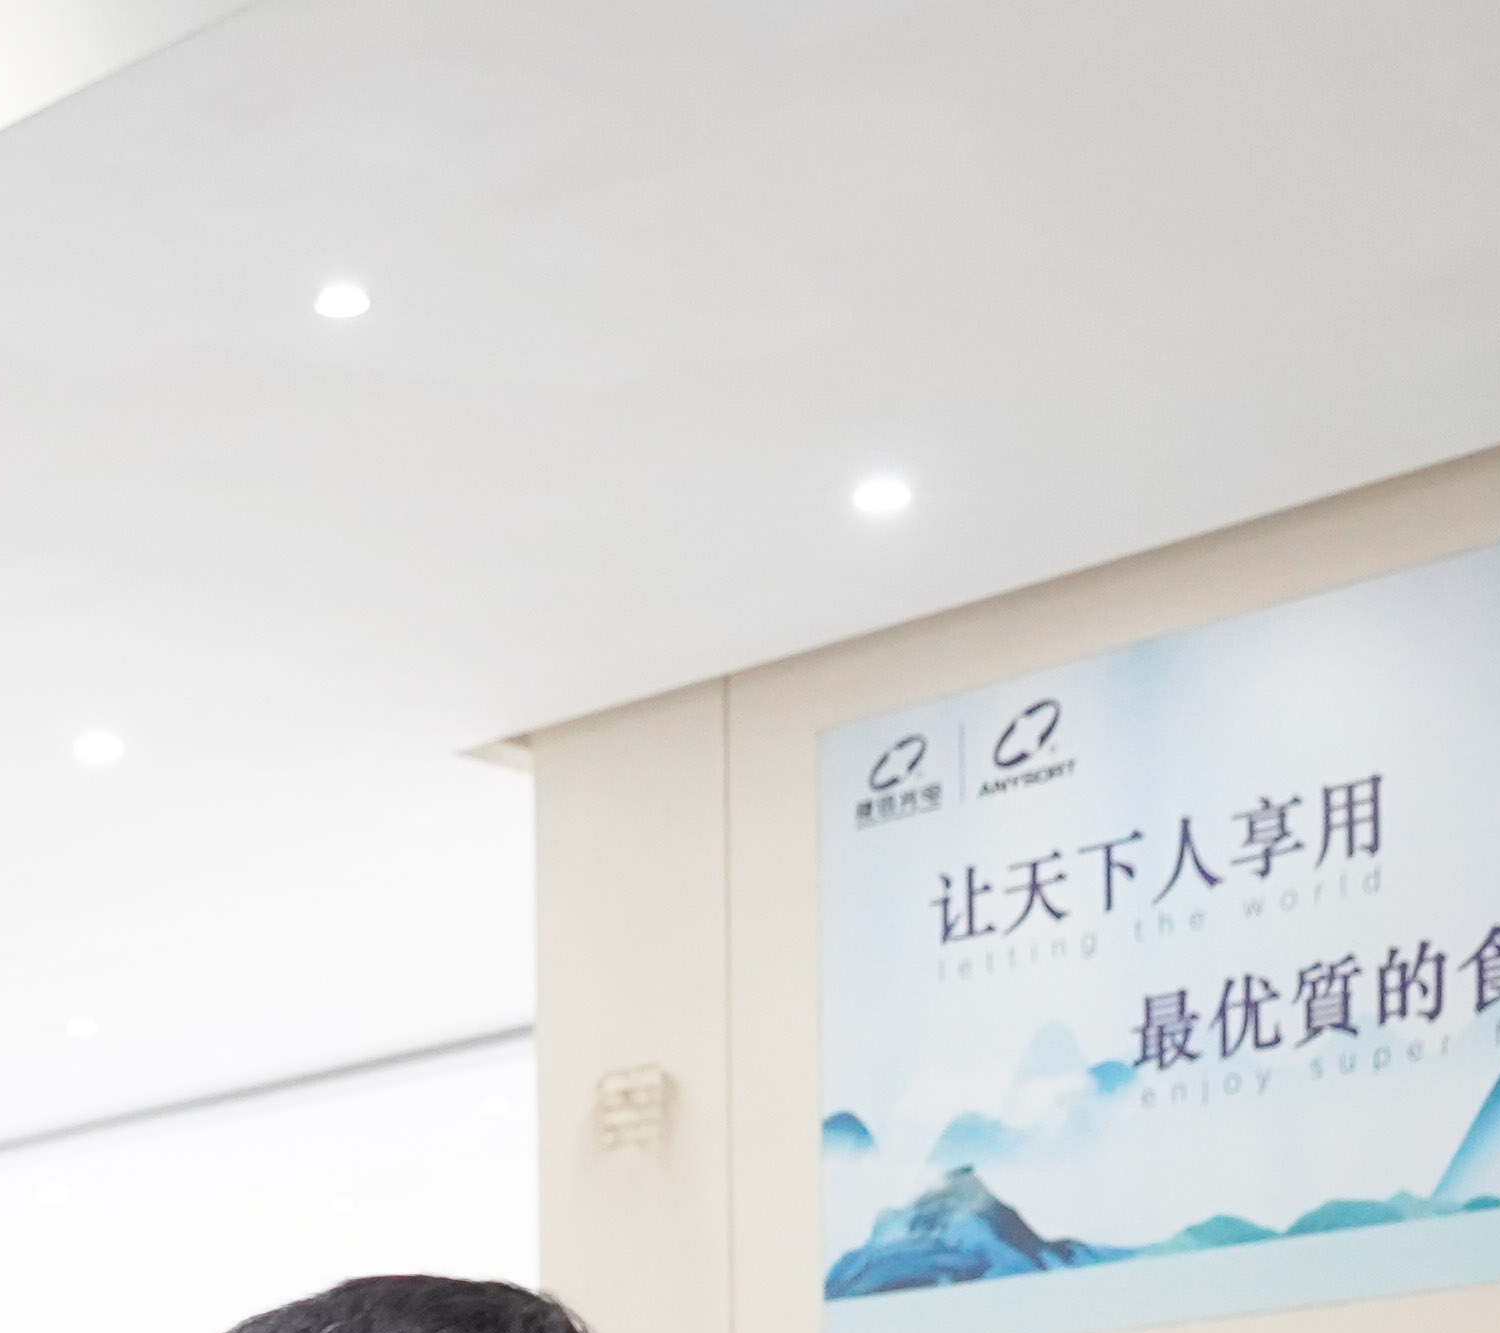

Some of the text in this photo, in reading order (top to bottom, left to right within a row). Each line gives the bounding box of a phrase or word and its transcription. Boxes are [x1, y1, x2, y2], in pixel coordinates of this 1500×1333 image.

[930, 773, 1383, 945] 让天下人享用
[937, 869, 1384, 981] letting the world
[1141, 1069, 1273, 1109] enjoy
[1310, 1037, 1453, 1080] super
